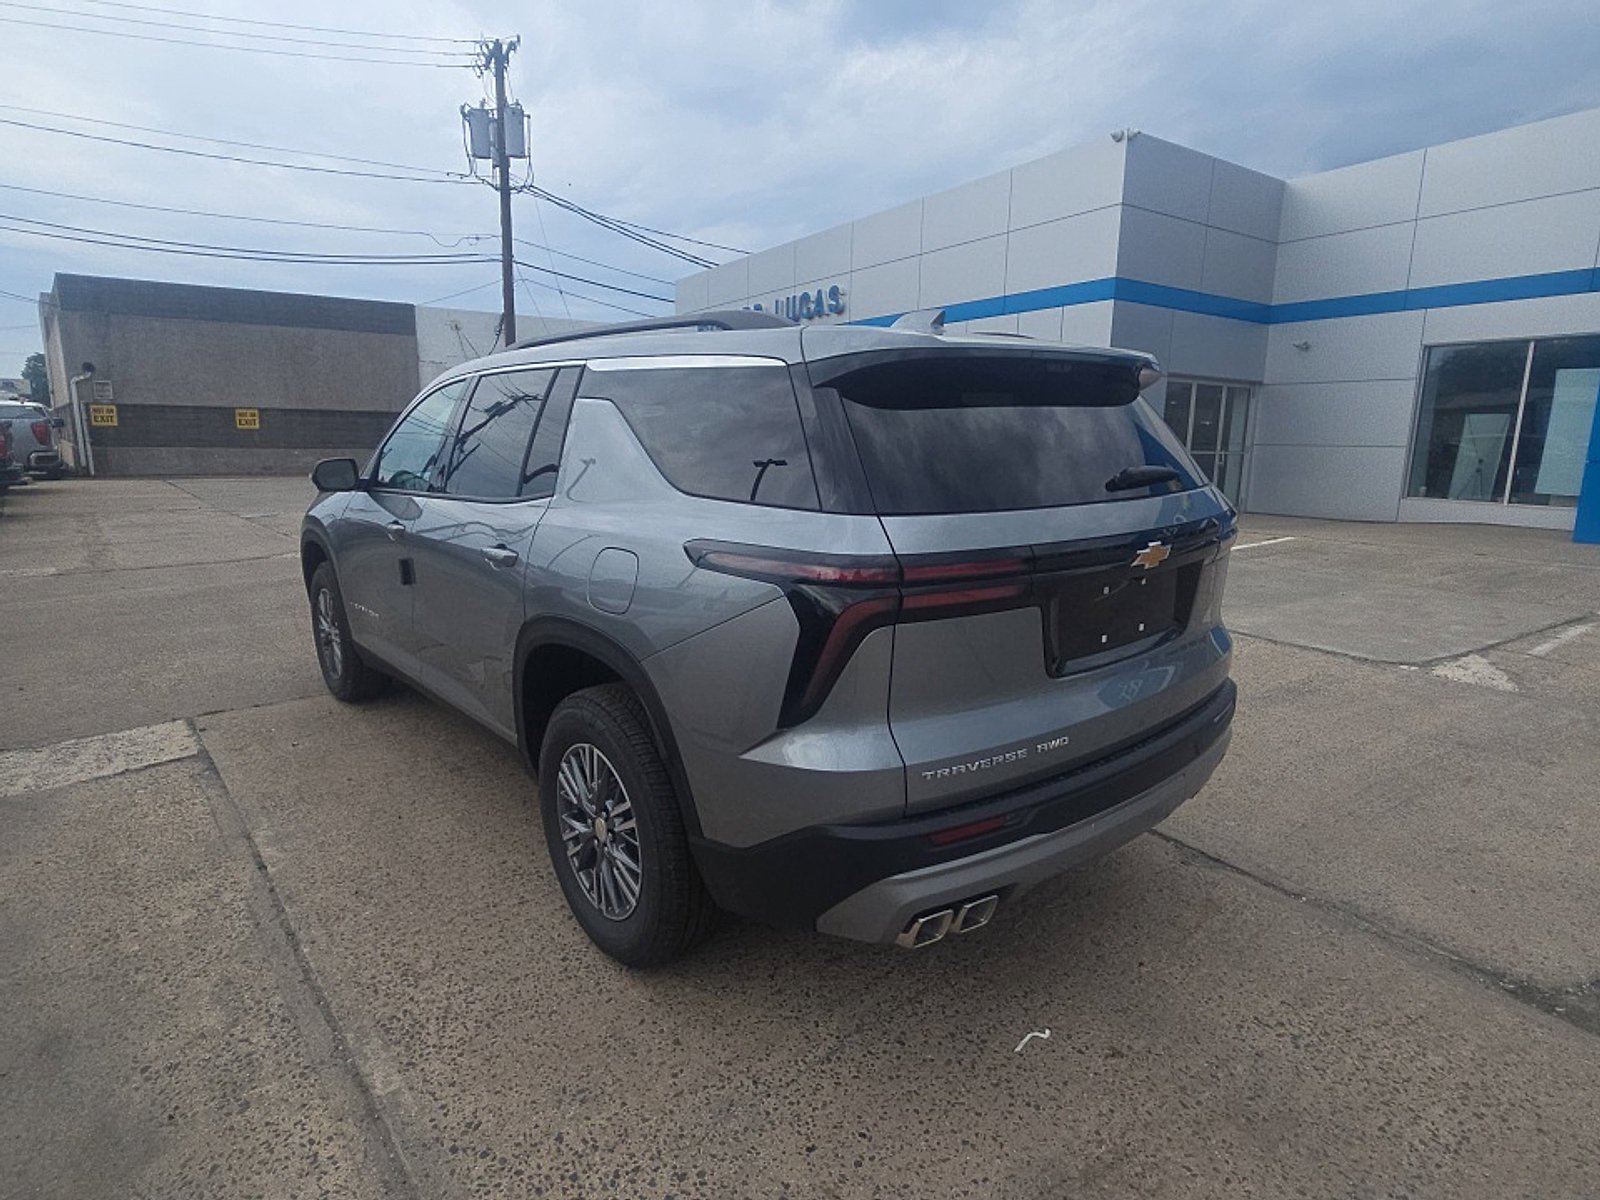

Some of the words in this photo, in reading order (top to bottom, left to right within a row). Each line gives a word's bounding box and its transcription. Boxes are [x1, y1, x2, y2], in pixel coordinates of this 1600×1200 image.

[93, 415, 114, 423] EXIT
[239, 418, 257, 426] EXIT
[922, 748, 1028, 781] TRAVERSE
[1036, 735, 1070, 753] AWD
